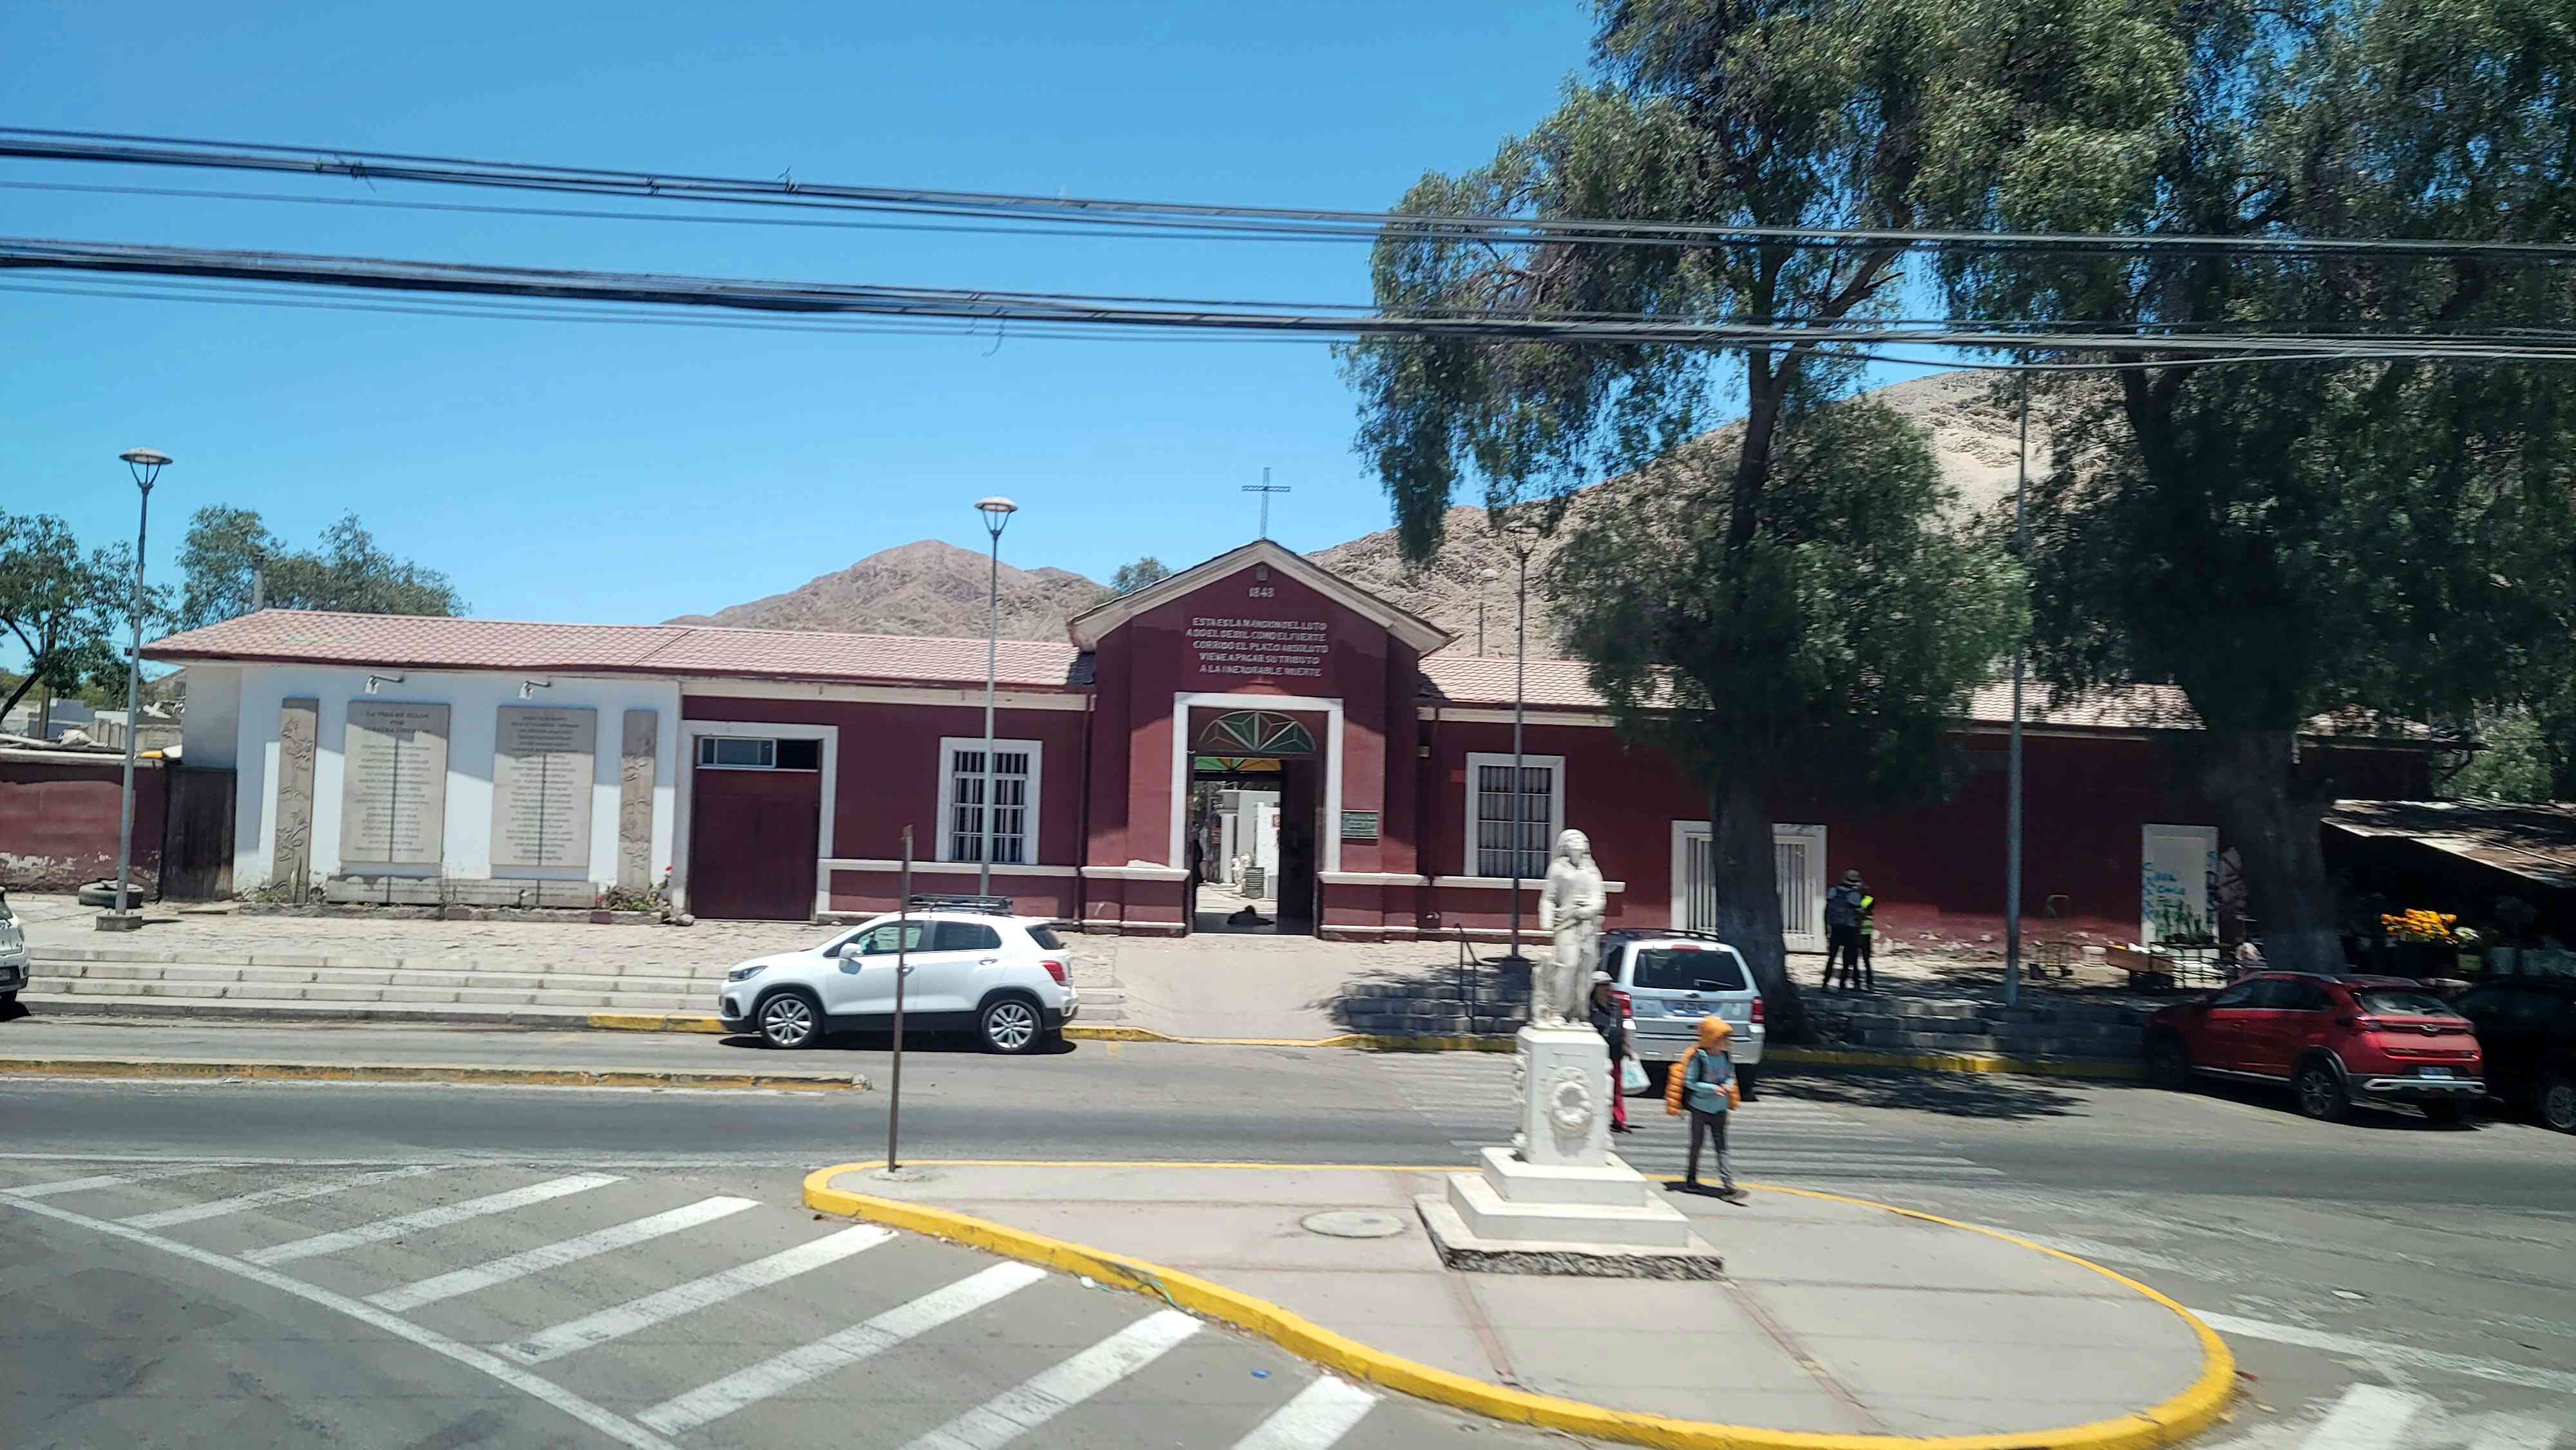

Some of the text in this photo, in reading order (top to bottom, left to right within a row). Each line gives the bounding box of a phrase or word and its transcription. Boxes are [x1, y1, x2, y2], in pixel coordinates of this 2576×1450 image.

[1249, 587, 1275, 598] 1848
[1192, 617, 1216, 626] ESTA
[1216, 618, 1229, 626] ES
[1229, 619, 1242, 627] LA
[1300, 622, 1328, 630] LUTO
[1206, 629, 1220, 637] EL
[1251, 631, 1277, 639] COMO
[1289, 633, 1327, 641] FUERTE
[1193, 641, 1235, 650] CORRIDO
[1235, 642, 1248, 650] EL
[1249, 643, 1280, 652] PLAZO
[1198, 652, 1227, 661] VIENE
[1235, 654, 1265, 663] PAGAR
[1265, 655, 1278, 663] SU
[1278, 655, 1320, 664] TRIBUTO
[1198, 664, 1207, 673] A
[1208, 664, 1221, 673] LA
[1283, 667, 1323, 677] MUERTE
